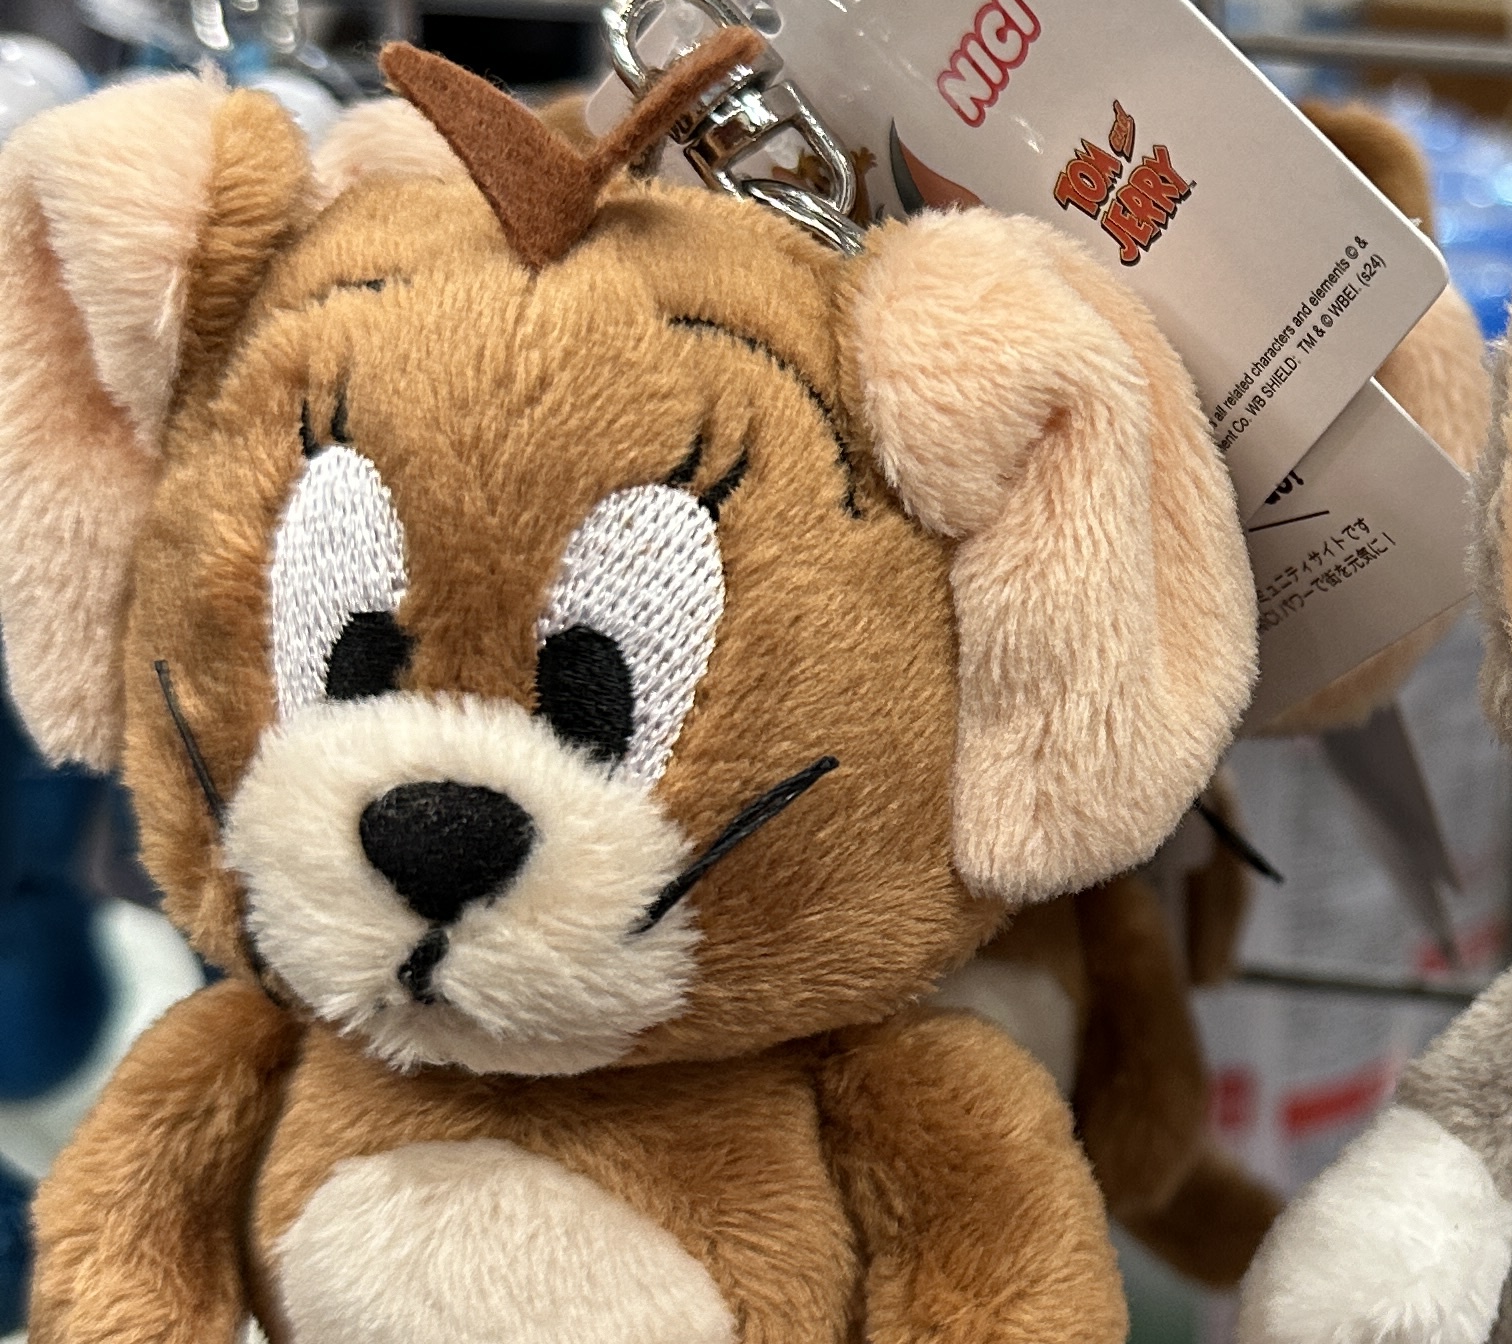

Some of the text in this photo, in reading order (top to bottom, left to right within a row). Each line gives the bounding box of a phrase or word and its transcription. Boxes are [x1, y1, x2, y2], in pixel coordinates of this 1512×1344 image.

[1054, 138, 1122, 219] TOM
[1101, 145, 1192, 267] JERRY
[1214, 404, 1228, 422] all
[1223, 373, 1255, 410] related
[1250, 325, 1296, 377] characters
[1292, 302, 1313, 327] and
[1309, 258, 1350, 307] elements
[1354, 235, 1369, 249] &
[1232, 417, 1253, 433] Co.
[1245, 395, 1266, 416] WB
[1261, 355, 1302, 398] SHIELD:
[1297, 332, 1318, 354] TM
[1312, 324, 1326, 338] &
[1356, 253, 1388, 287] (s24)
